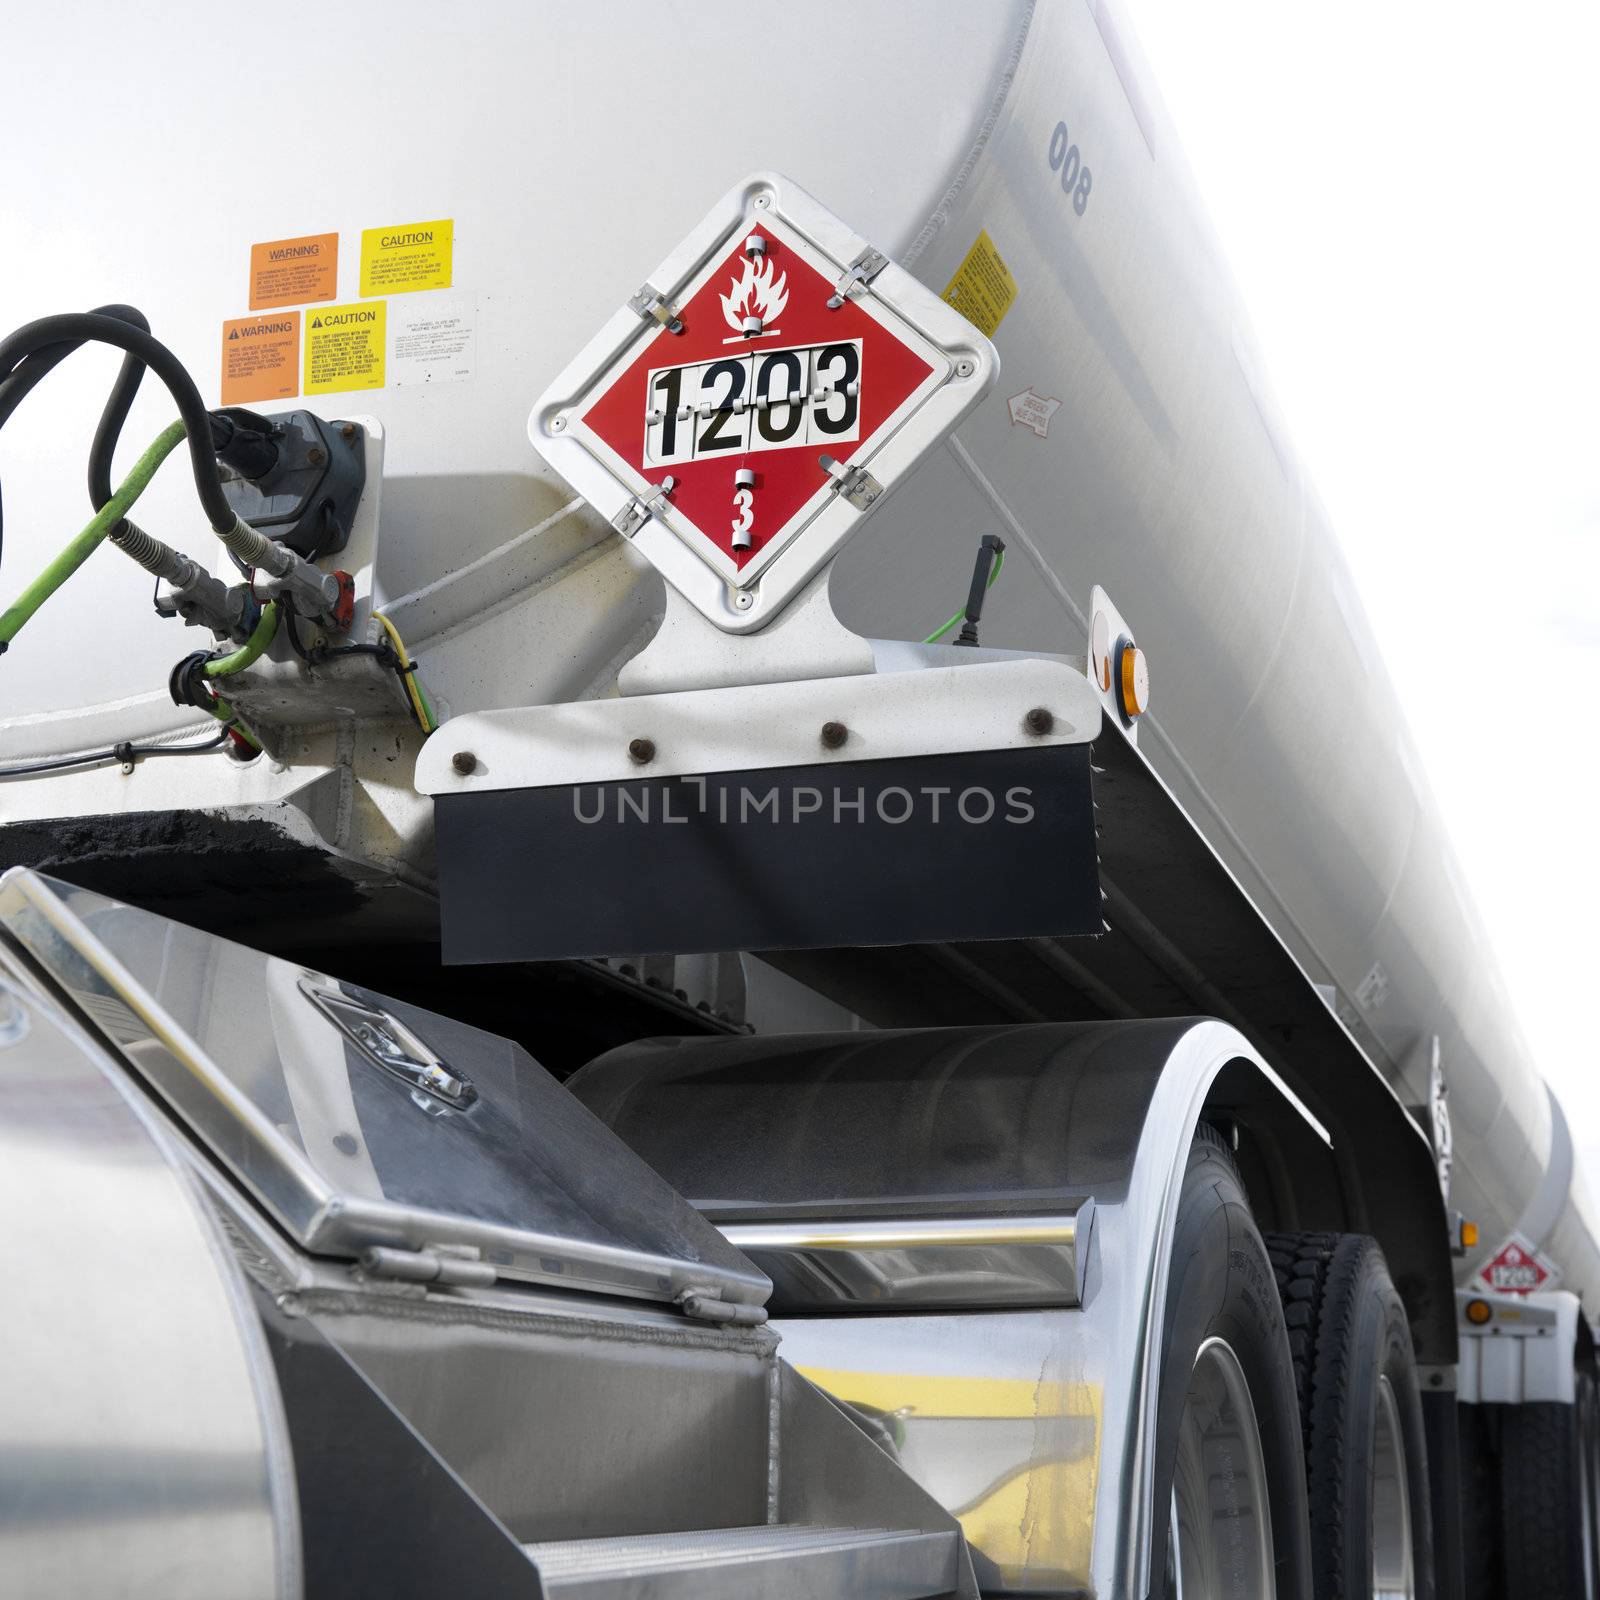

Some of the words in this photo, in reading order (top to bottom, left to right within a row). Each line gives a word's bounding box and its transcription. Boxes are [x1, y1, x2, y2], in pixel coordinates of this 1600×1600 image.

[1049, 121, 1092, 216] 008
[381, 232, 433, 247] CAUTION
[269, 244, 319, 260] WARNING
[324, 311, 376, 326] CAUTION
[241, 322, 292, 337] WARNING
[655, 343, 859, 456] 1203
[731, 488, 754, 533] 3
